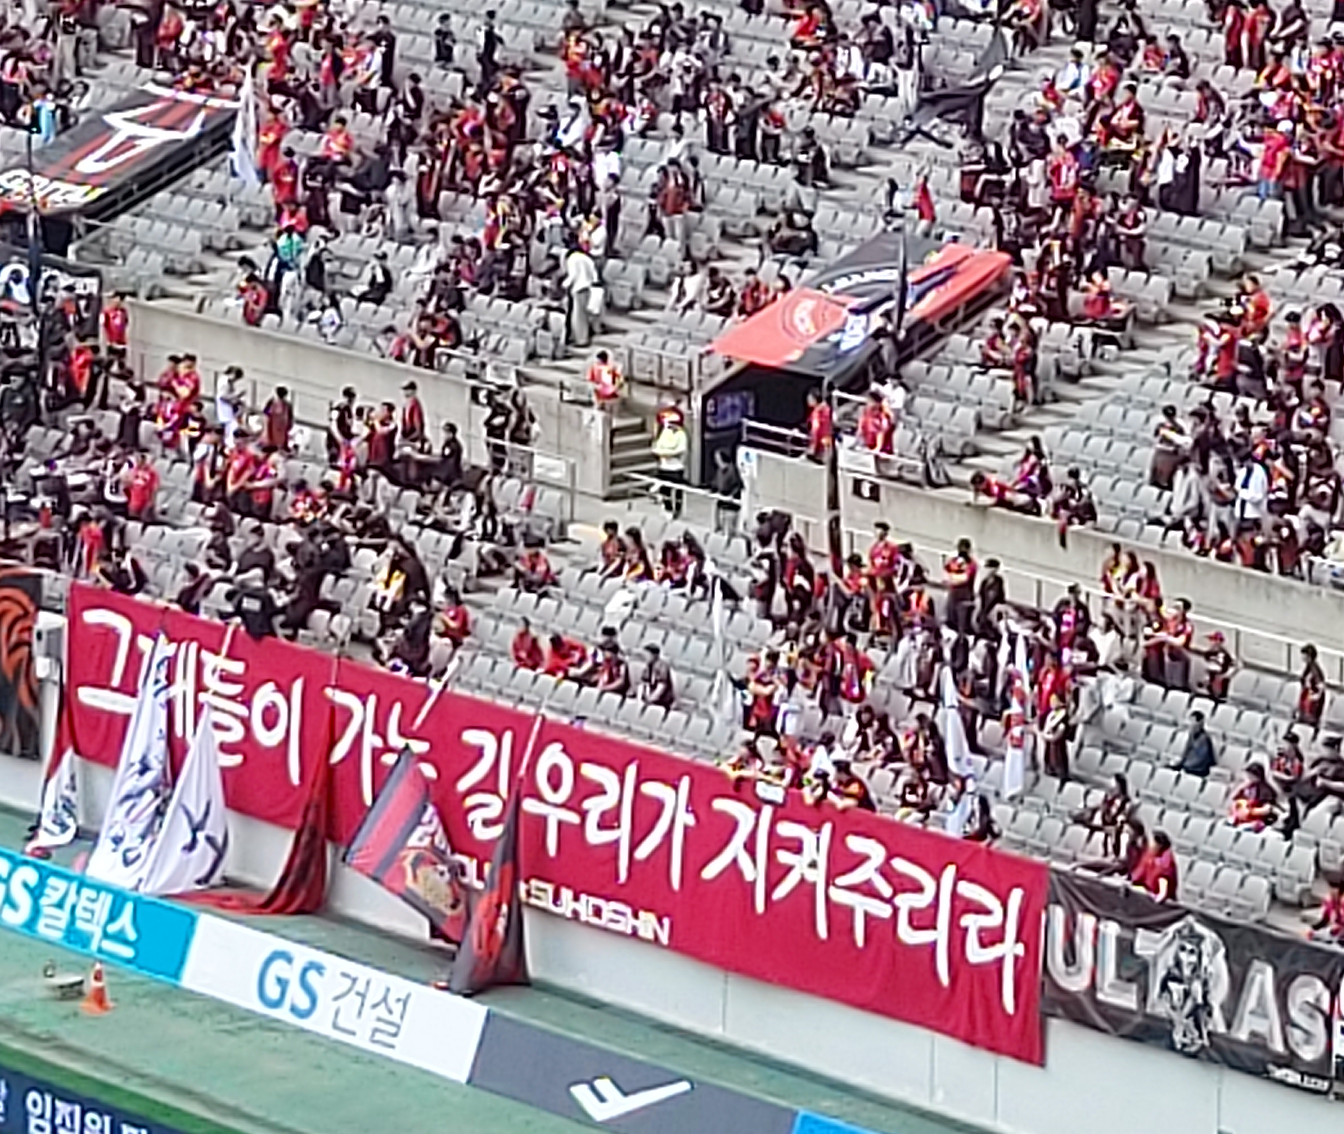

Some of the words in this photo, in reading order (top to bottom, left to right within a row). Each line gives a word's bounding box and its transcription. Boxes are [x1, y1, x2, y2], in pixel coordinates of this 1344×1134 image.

[522, 742, 695, 891] 우리가
[701, 797, 1026, 1015] 지켜주리라
[530, 877, 670, 946] SUHOSHIN
